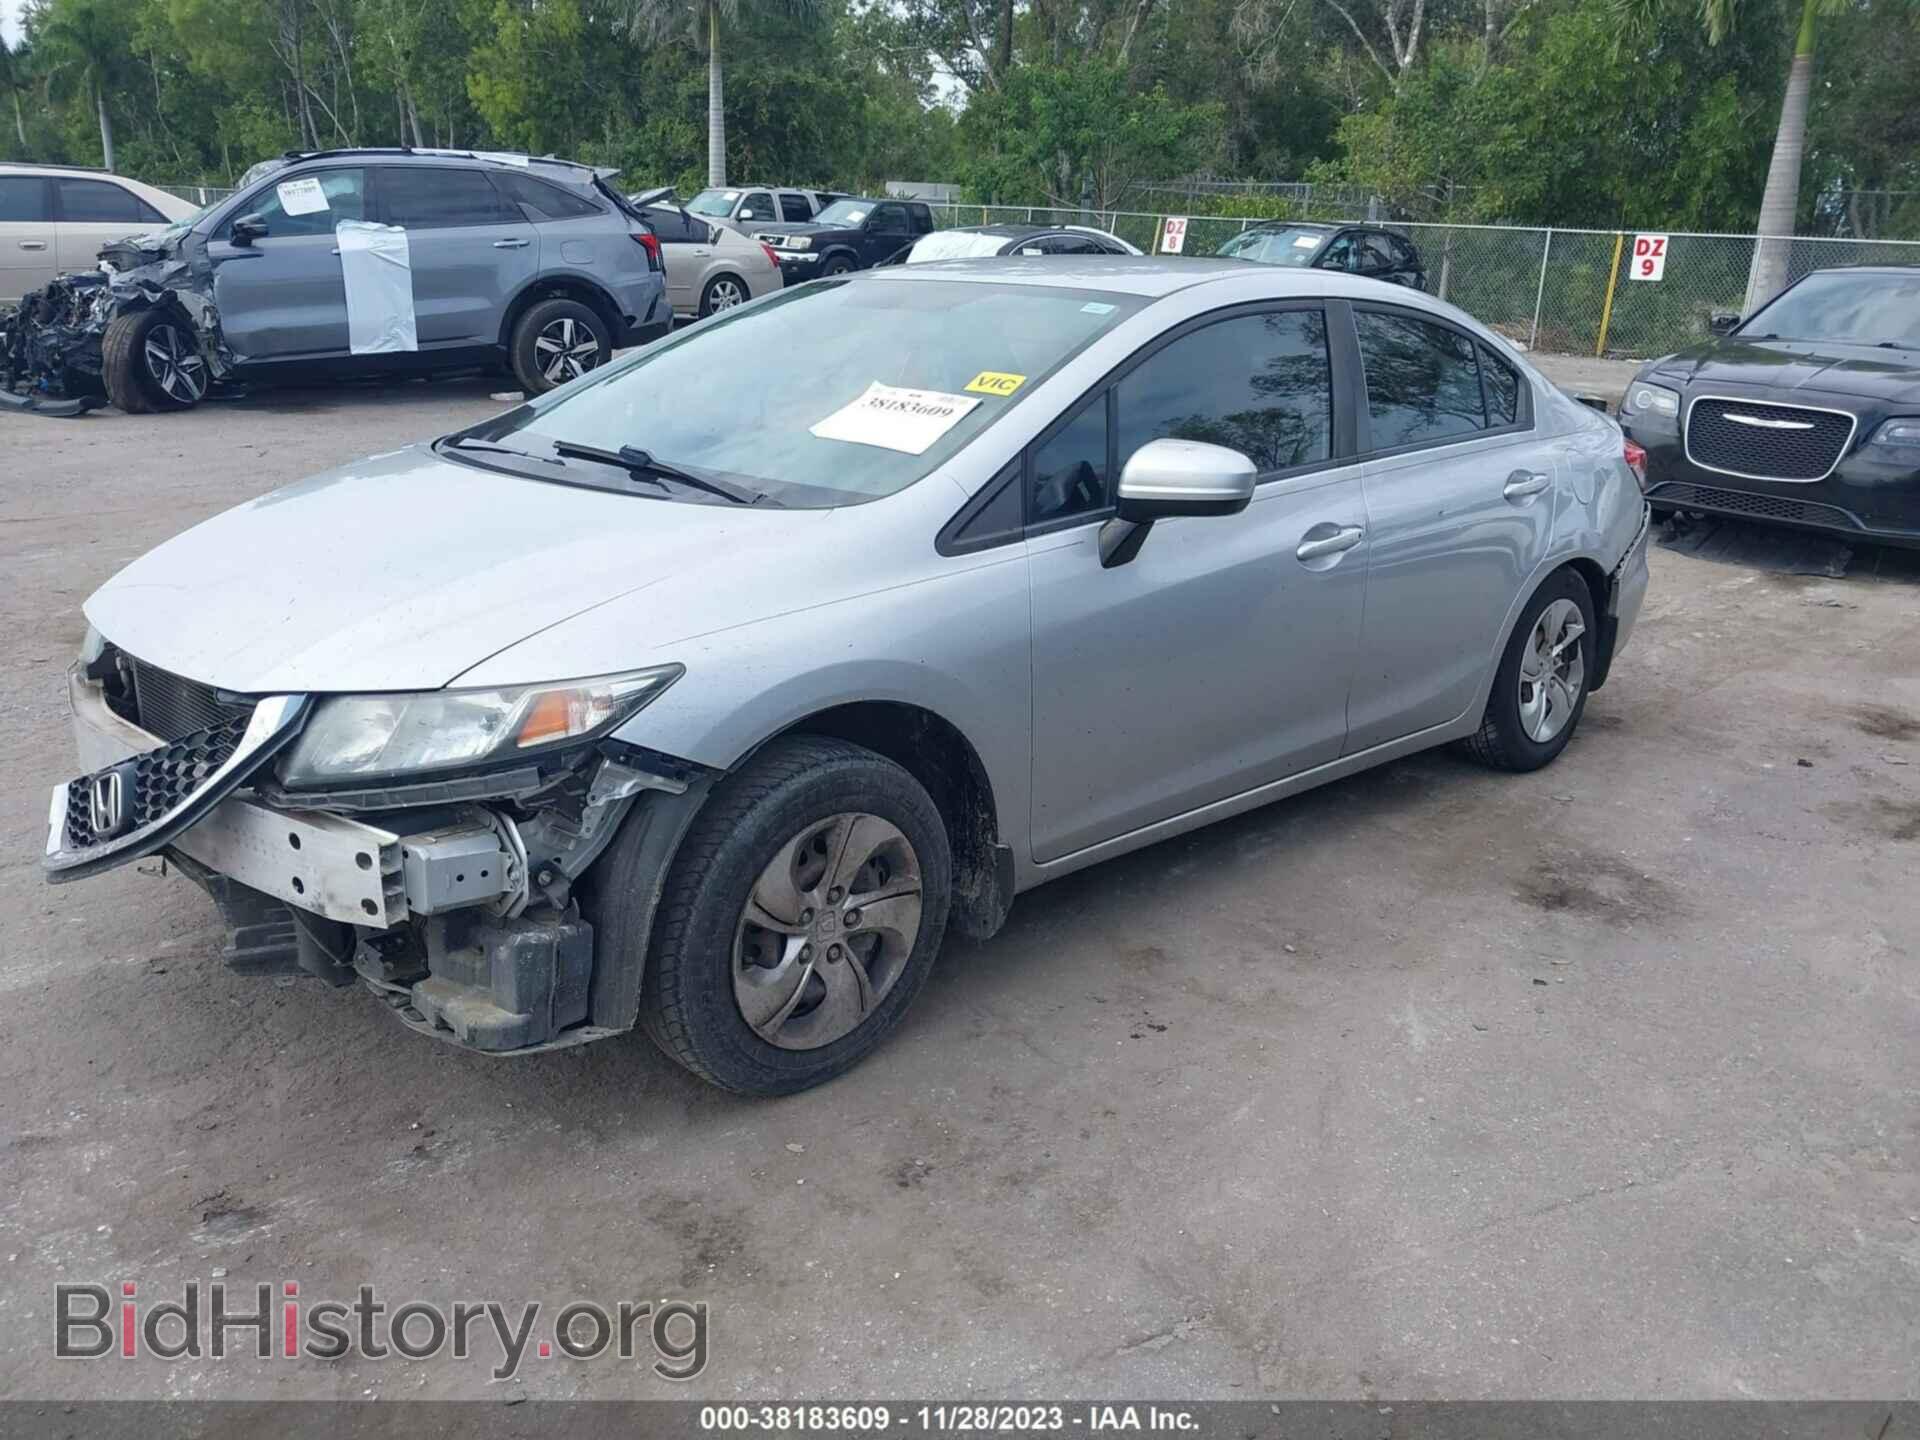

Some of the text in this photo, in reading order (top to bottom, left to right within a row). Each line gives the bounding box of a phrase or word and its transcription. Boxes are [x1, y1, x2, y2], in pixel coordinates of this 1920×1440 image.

[1166, 220, 1185, 234] DZ
[1168, 235, 1177, 249] 8
[1635, 239, 1665, 256] DZ
[1641, 258, 1654, 276] 9
[977, 375, 1018, 391] VIC
[862, 396, 955, 418] 38183609
